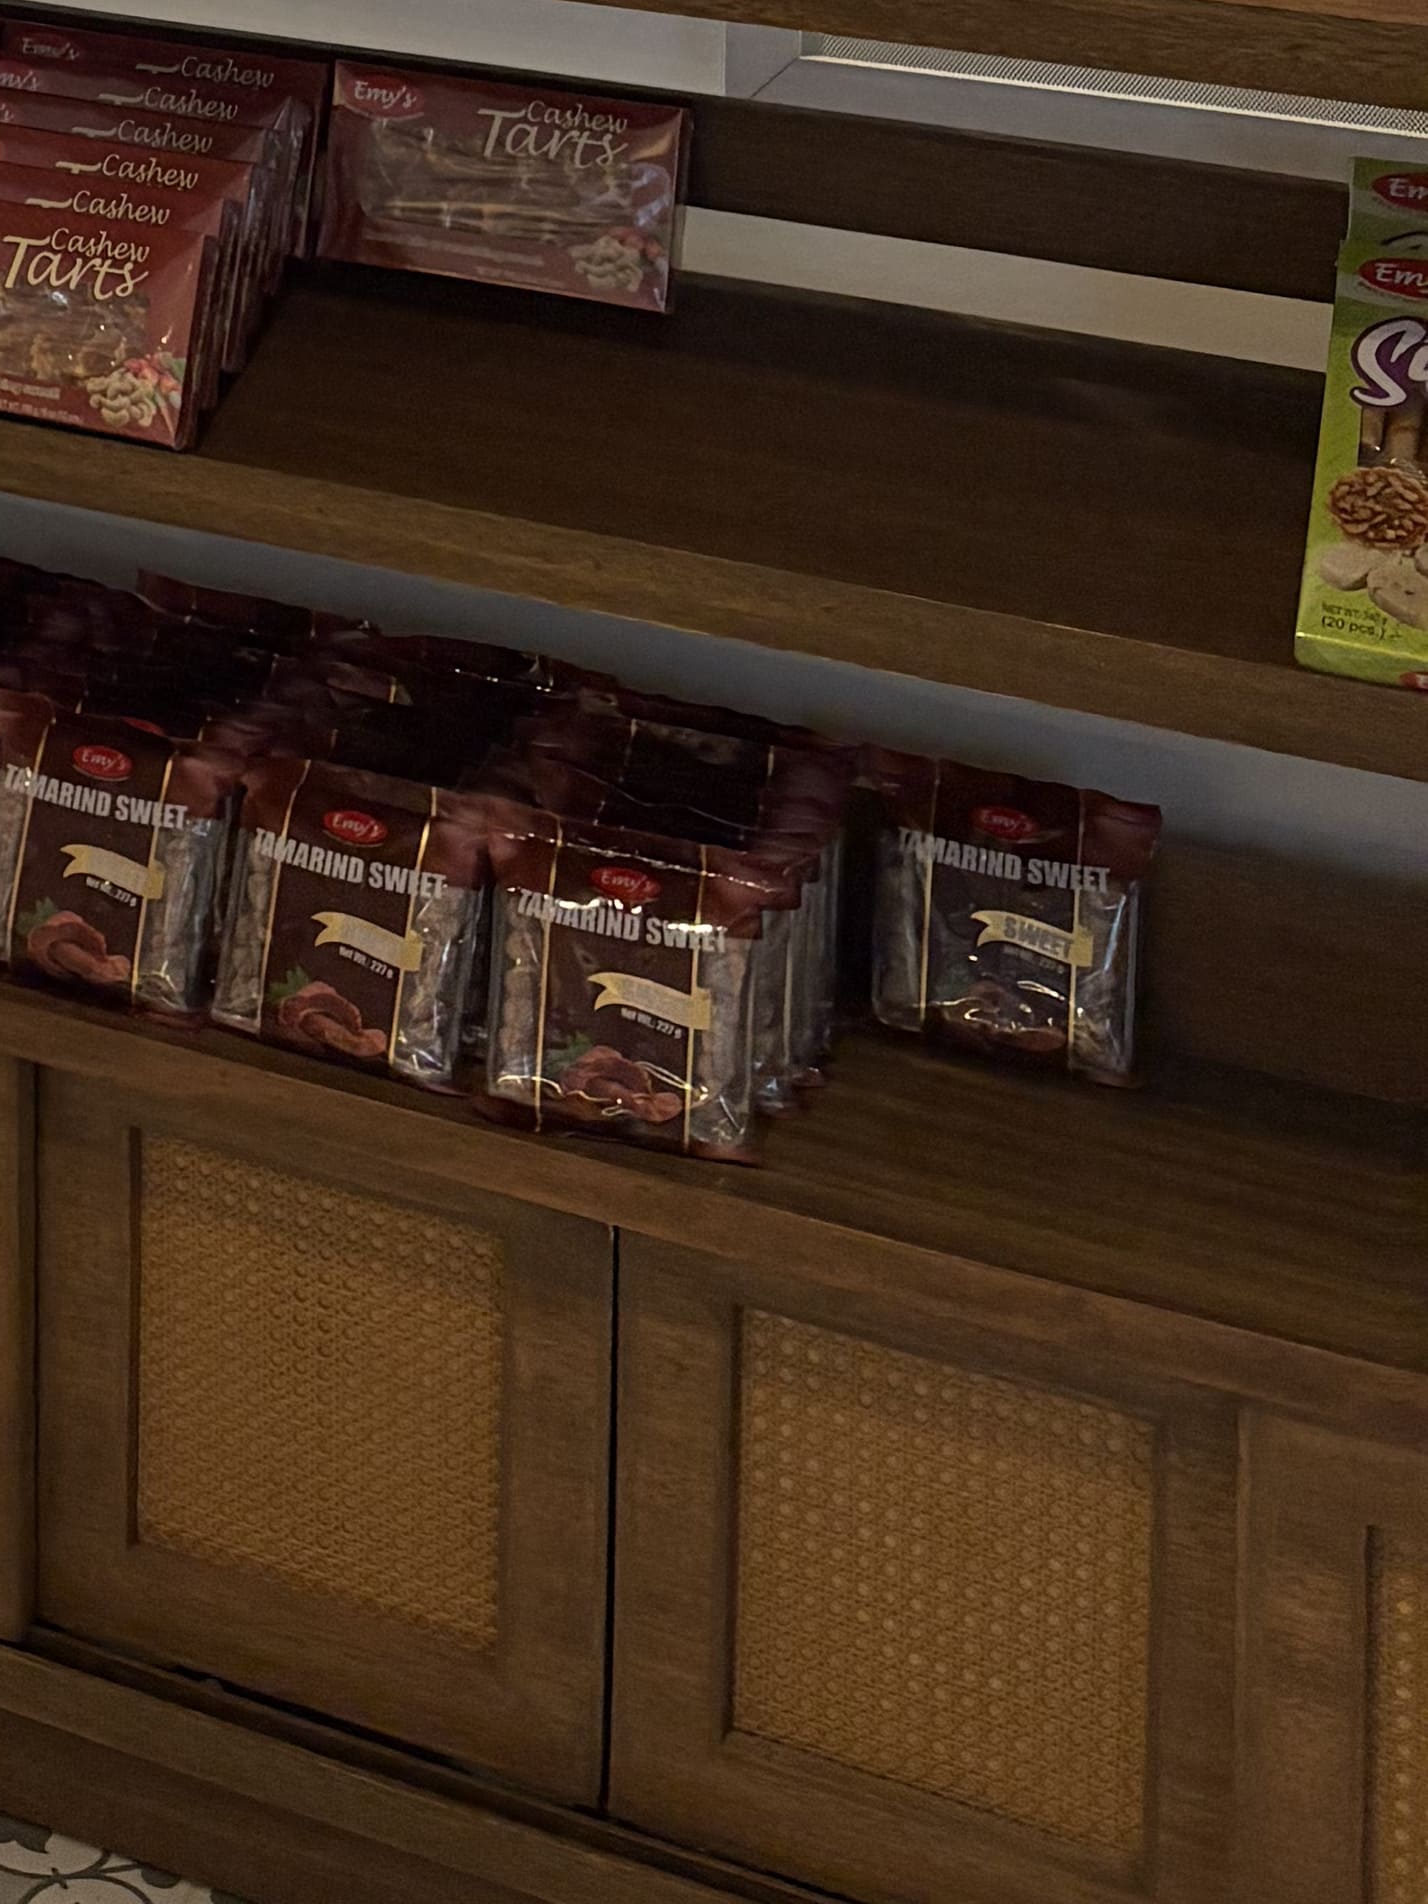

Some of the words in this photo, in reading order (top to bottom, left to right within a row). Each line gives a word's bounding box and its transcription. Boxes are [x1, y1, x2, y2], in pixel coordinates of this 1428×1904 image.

[180, 56, 275, 89] Cashew
[145, 87, 239, 120] Cashew
[353, 79, 418, 109] Emy's
[117, 119, 214, 154] Cashew
[526, 101, 628, 135] Cashew
[477, 107, 627, 168] Tarts
[101, 154, 199, 191] Cashew
[72, 191, 171, 226] Cashew
[50, 228, 151, 266] Cashew
[2, 235, 149, 301] Tarts
[4, 763, 111, 818] TAMARIND
[114, 795, 189, 829] SWEET
[254, 827, 364, 884] TAMARIND
[368, 862, 448, 899] SWEET
[898, 827, 1022, 881] TAMARIND
[1027, 858, 1110, 893] SWEET
